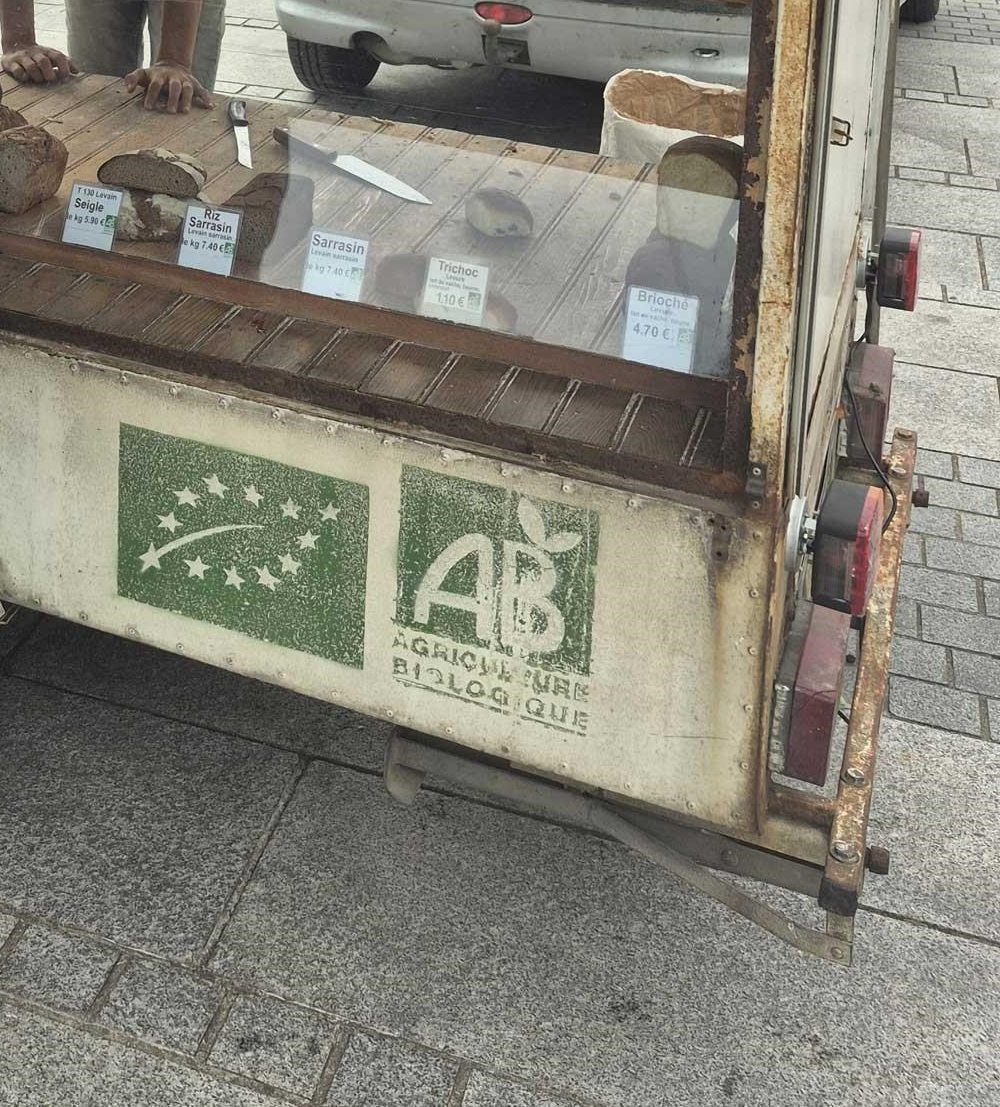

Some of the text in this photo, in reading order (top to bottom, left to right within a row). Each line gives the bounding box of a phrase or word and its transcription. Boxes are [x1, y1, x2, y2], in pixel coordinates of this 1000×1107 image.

[84, 189, 94, 197] 130
[96, 190, 118, 200] Levain
[74, 198, 104, 213] Seigle
[74, 213, 83, 224] kg
[84, 215, 99, 225] 5.90
[204, 208, 220, 221] Riz
[189, 216, 232, 234] Sarrasin
[190, 239, 200, 250] kg
[202, 240, 218, 251] 7.40
[219, 244, 225, 253] €
[312, 234, 365, 255] Sarrasin
[439, 260, 479, 278] Trichoc
[458, 296, 465, 308] €
[633, 322, 672, 340] 4.70 €
[413, 532, 567, 653] AB
